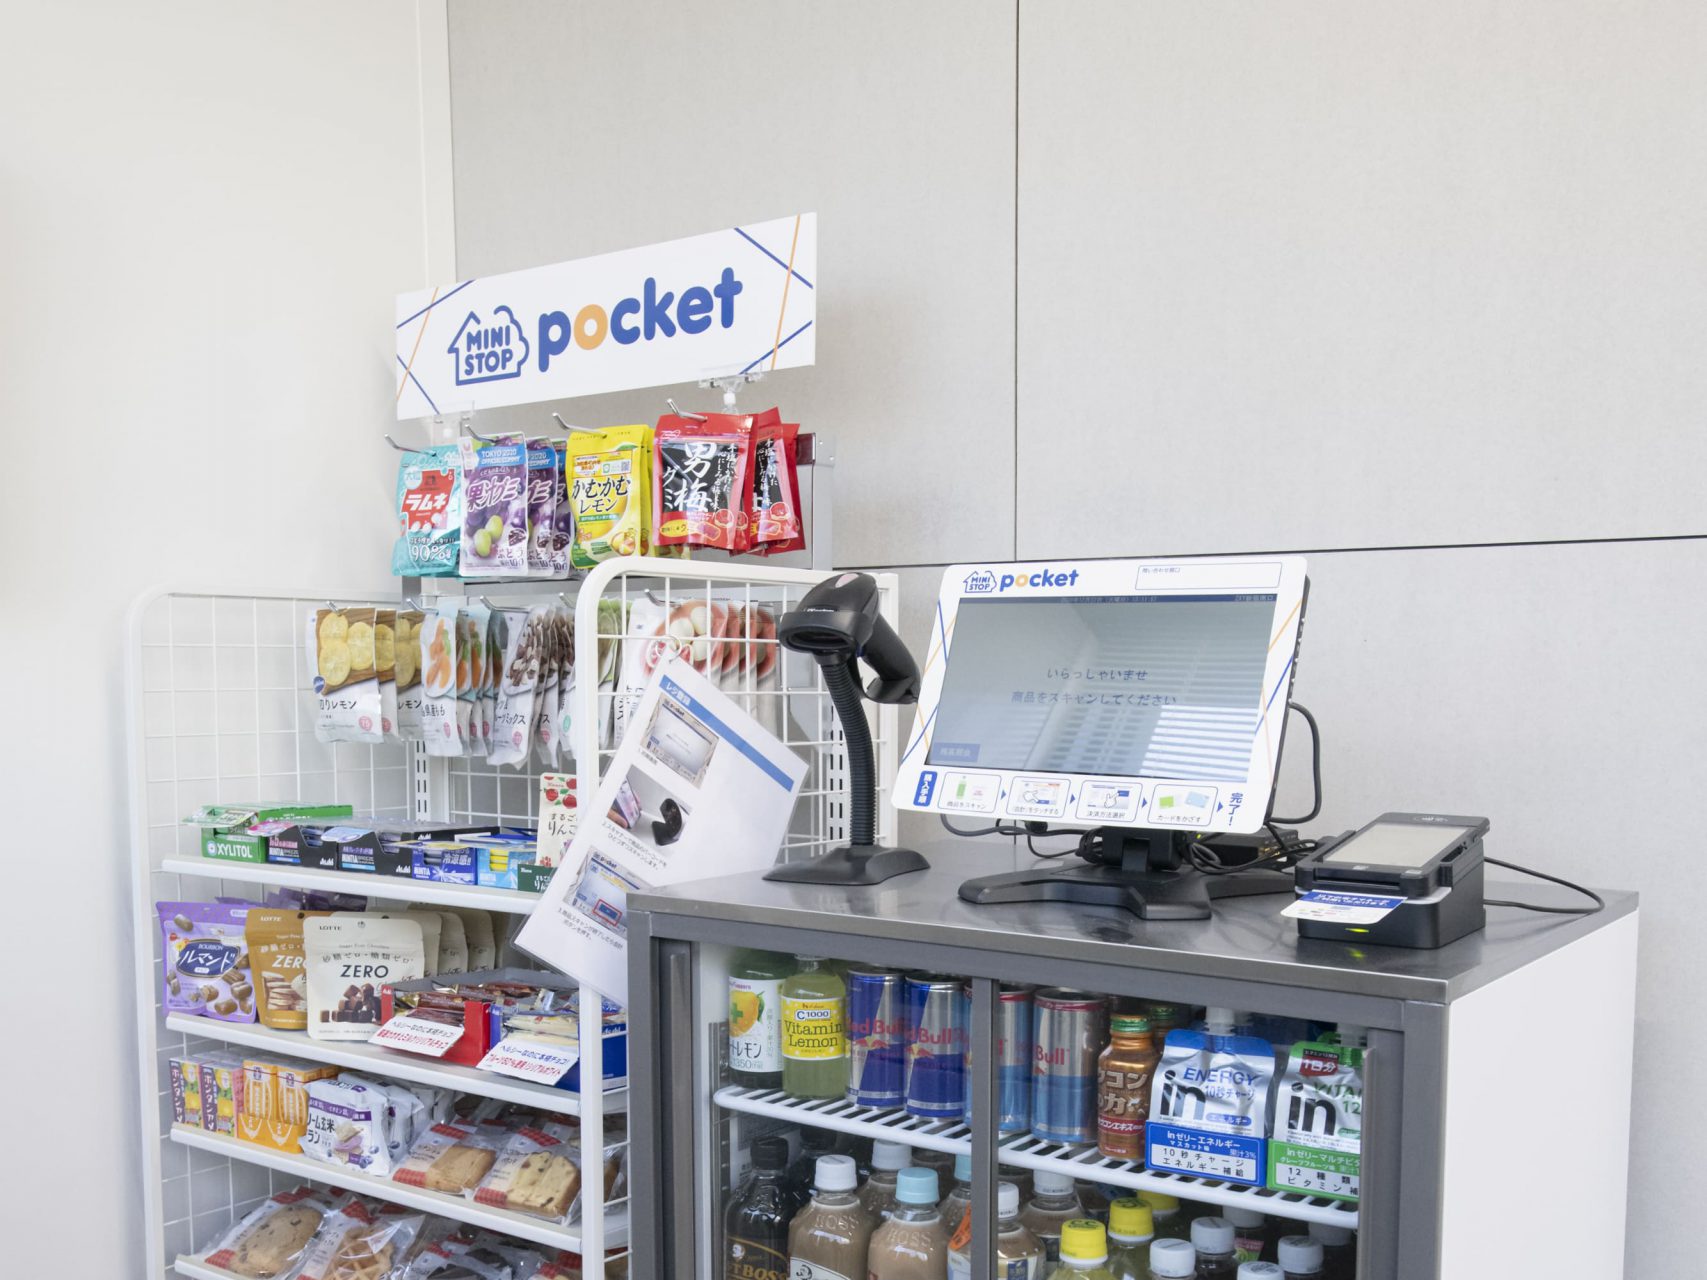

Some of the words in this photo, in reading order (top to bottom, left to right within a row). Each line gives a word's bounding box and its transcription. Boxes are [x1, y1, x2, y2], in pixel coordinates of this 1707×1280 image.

[538, 267, 743, 372] pocket
[466, 325, 511, 351] MINI
[464, 349, 514, 376] STOP
[672, 441, 715, 513] 男梅
[572, 476, 631, 499] かむかむ
[406, 492, 449, 511] ラムネ
[580, 499, 618, 514] レモン
[968, 583, 992, 592] STOP
[970, 575, 993, 586] MINI
[1000, 568, 1079, 593] pocket
[1047, 668, 1149, 681] いらっしゃいませ
[1011, 690, 1177, 706] 商品をスキャンしてください
[1156, 813, 1203, 824] カードをかざす
[216, 842, 253, 858] XYLITOL
[177, 950, 236, 973] ルマンド
[272, 955, 307, 969] ZER
[340, 965, 389, 979] ZERO
[784, 1020, 842, 1035] Vitamin
[918, 1027, 952, 1045] Bull
[788, 1034, 838, 1049] Lemon
[1183, 1067, 1259, 1086] ENERGY
[1160, 1070, 1206, 1120] in
[1288, 1082, 1337, 1136] in
[1163, 1147, 1245, 1167] 10秒チャージ
[1162, 1157, 1245, 1178] エネルギー補給
